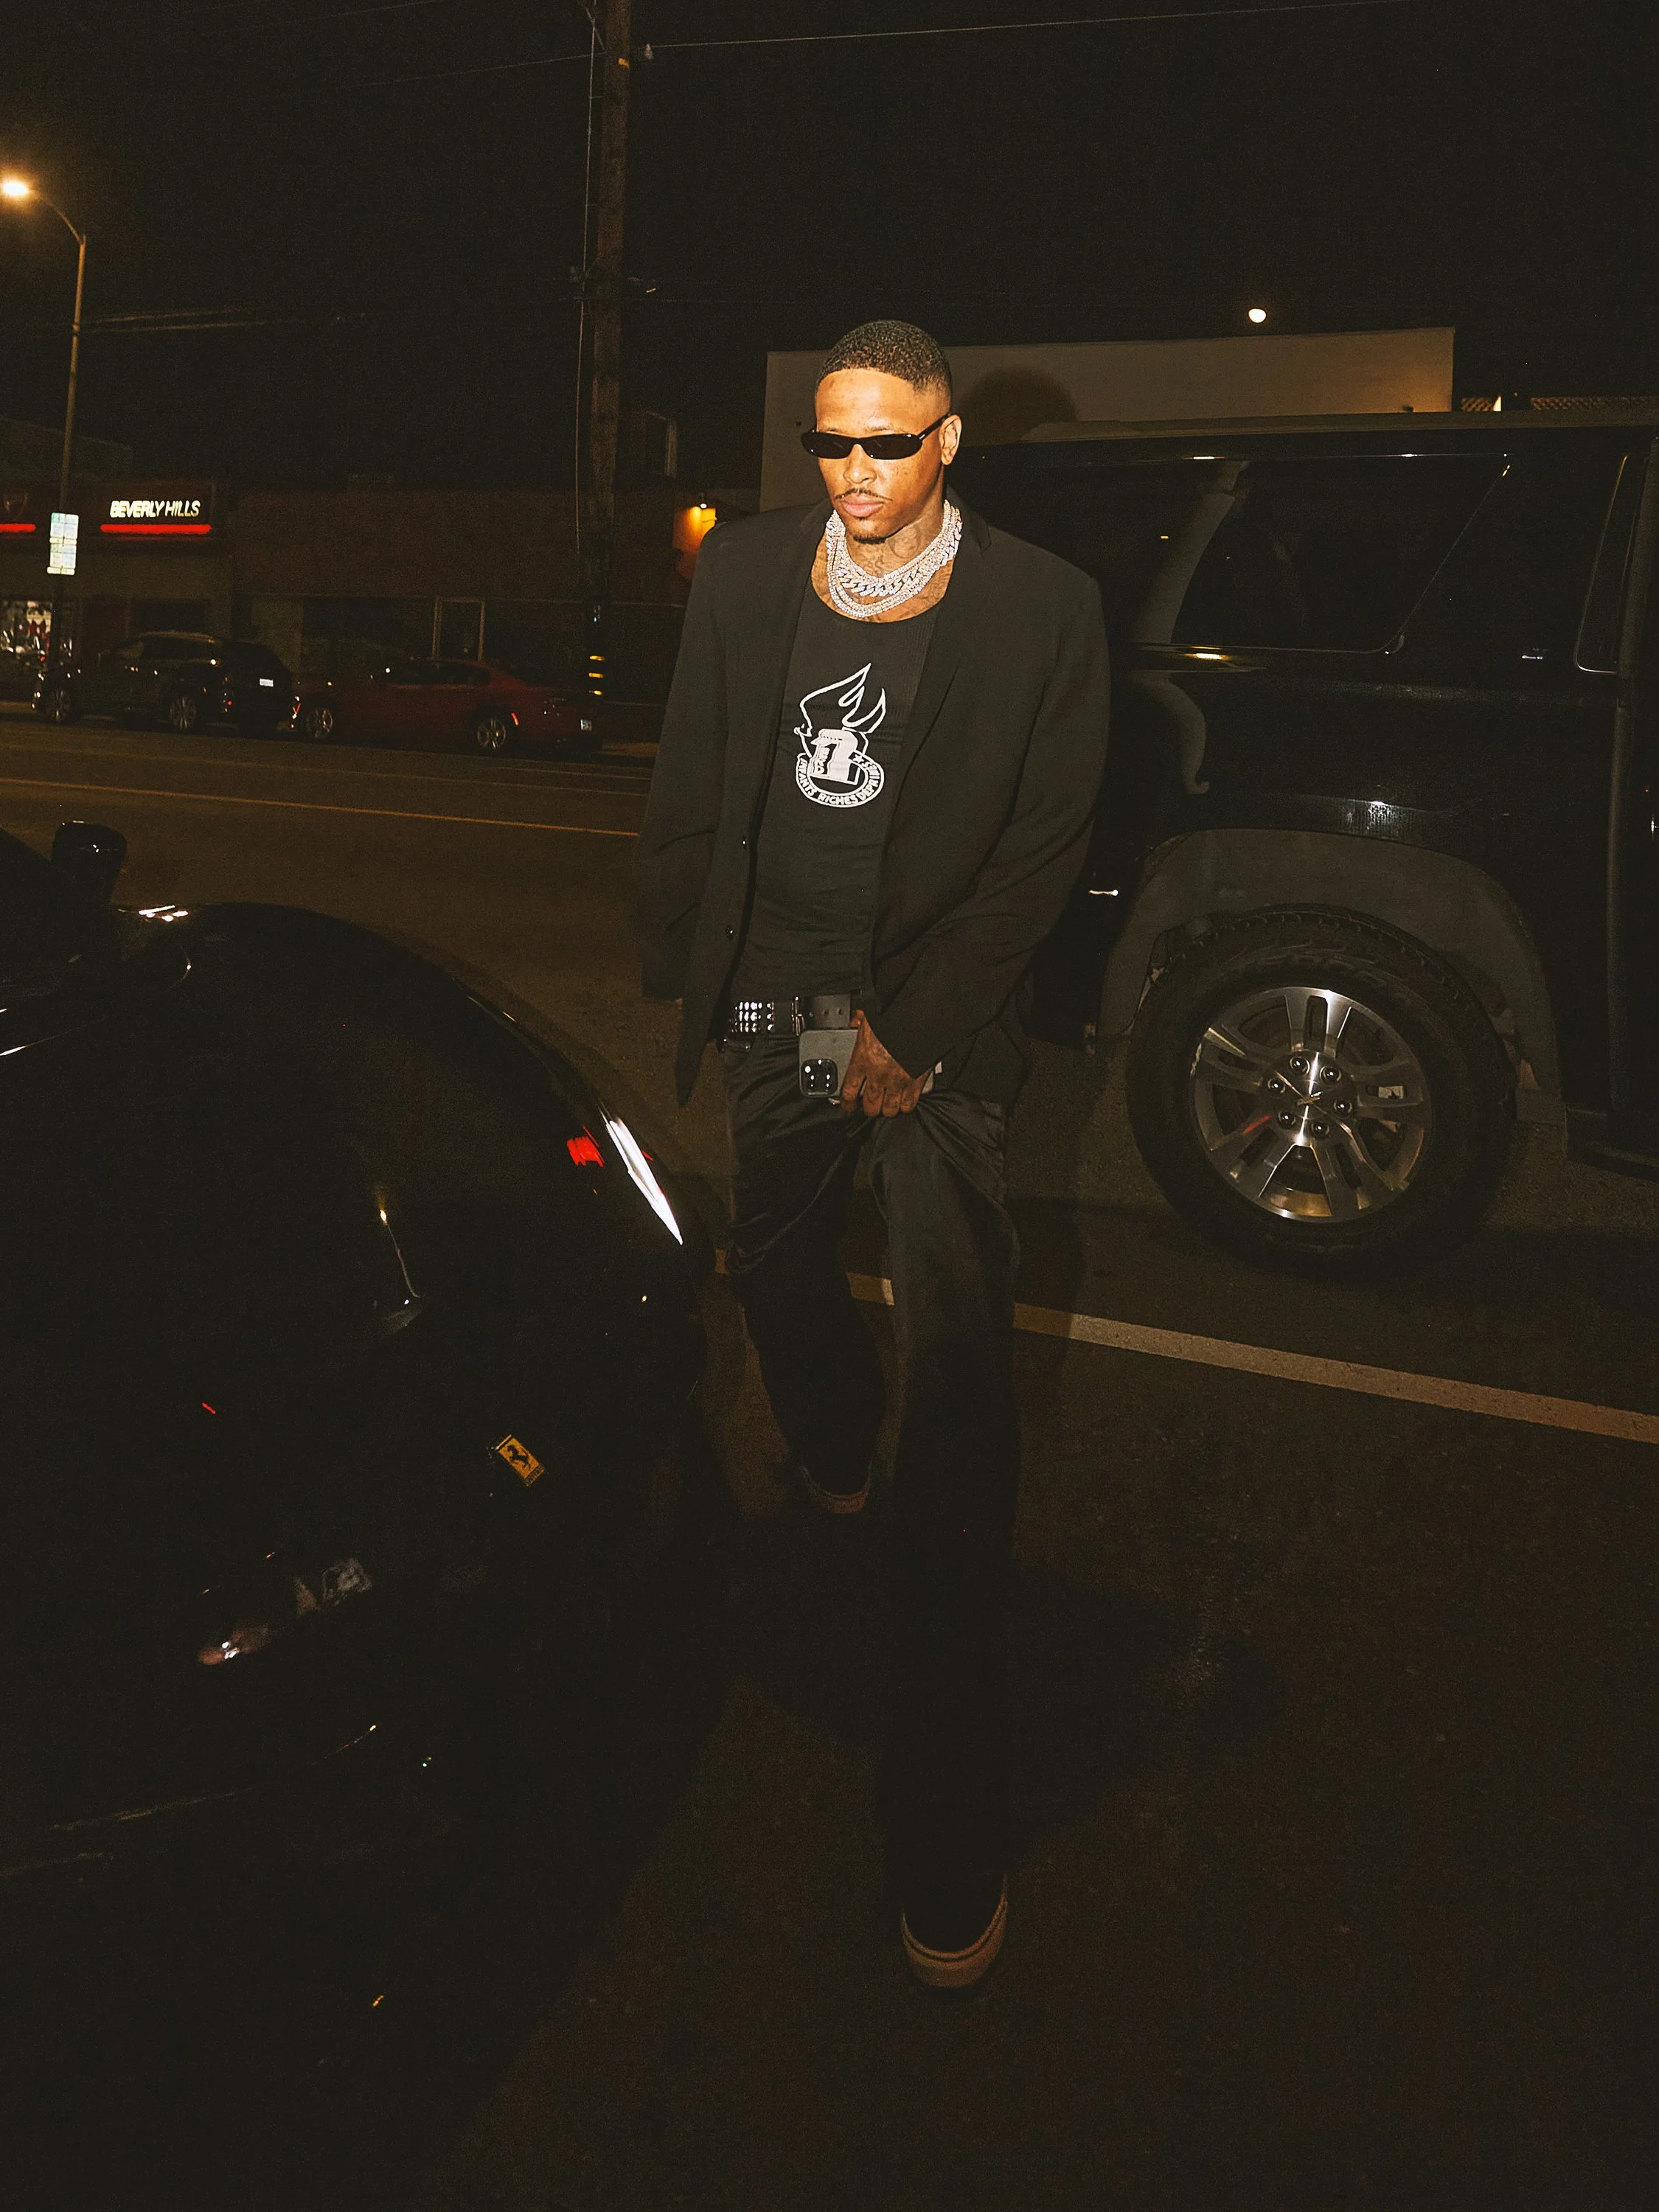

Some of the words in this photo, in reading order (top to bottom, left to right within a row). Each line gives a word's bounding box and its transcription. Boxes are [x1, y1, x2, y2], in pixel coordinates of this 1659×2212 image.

[110, 500, 164, 518] BEVERLY
[165, 500, 201, 517] HILLS
[818, 793, 858, 805] RICHES
